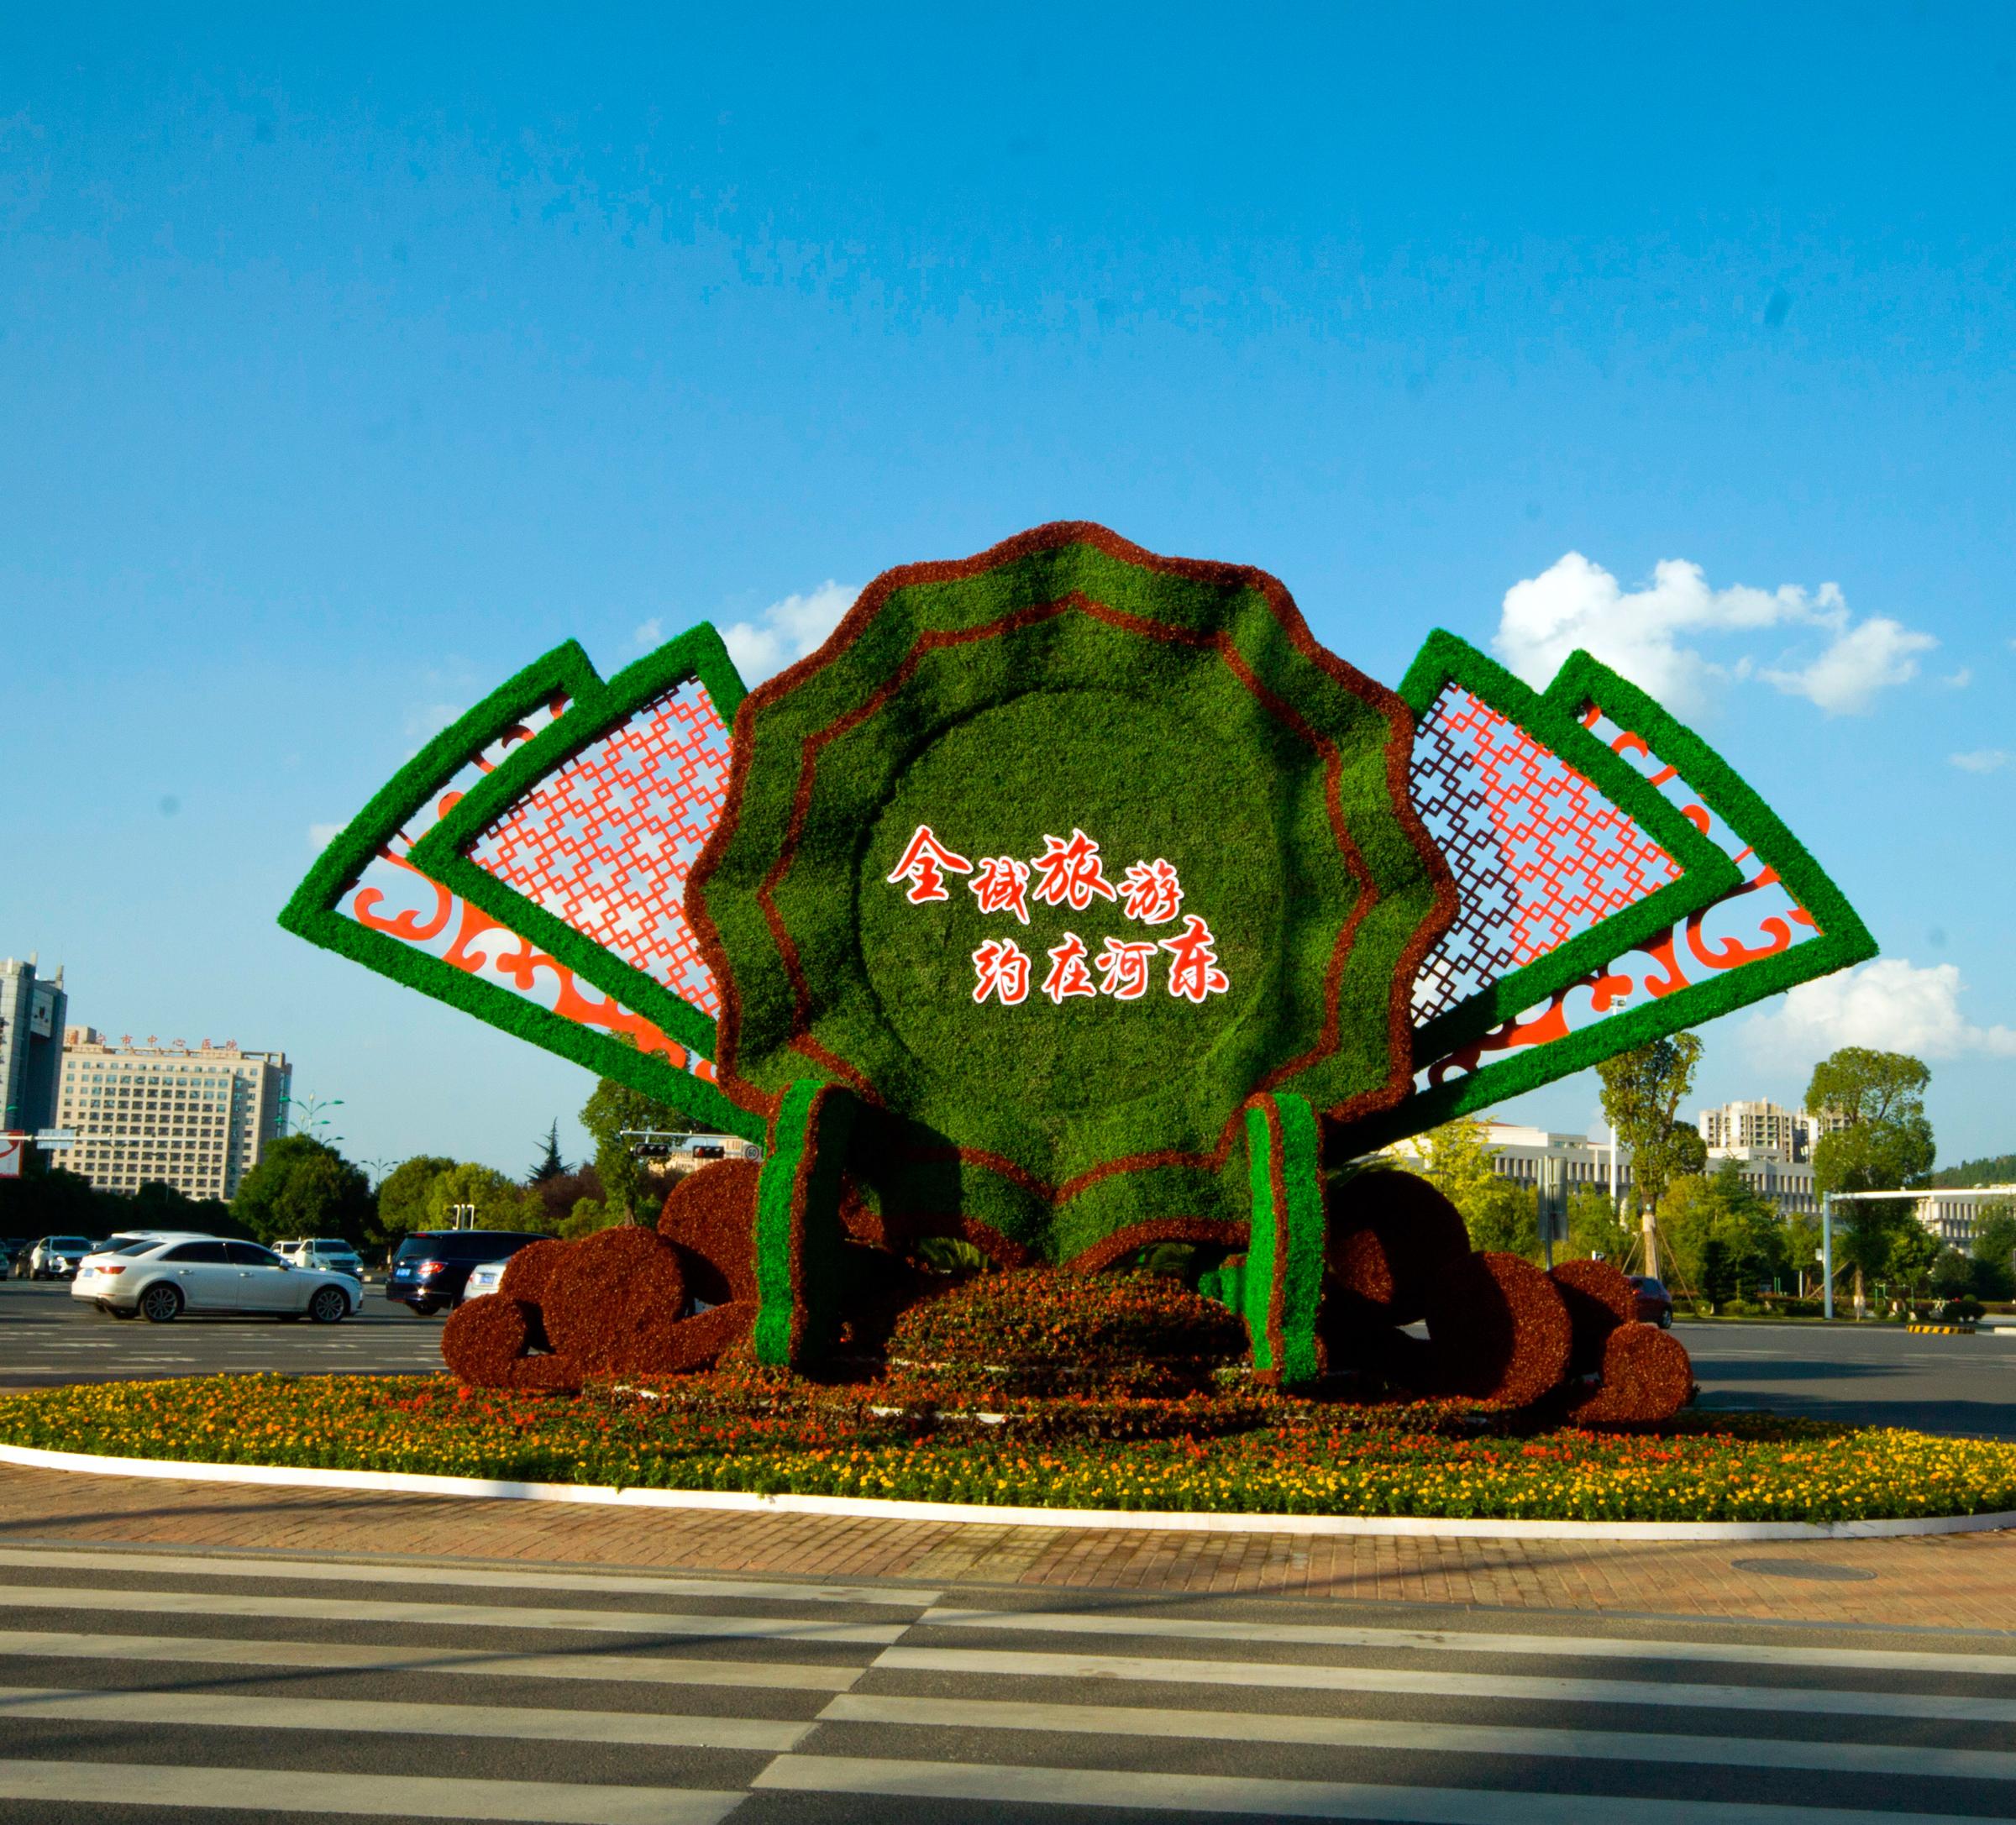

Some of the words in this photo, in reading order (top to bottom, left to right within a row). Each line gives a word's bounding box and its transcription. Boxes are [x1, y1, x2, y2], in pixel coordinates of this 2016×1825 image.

[887, 824, 1184, 925] 全域旅游
[972, 915, 1229, 1005] 约在河东
